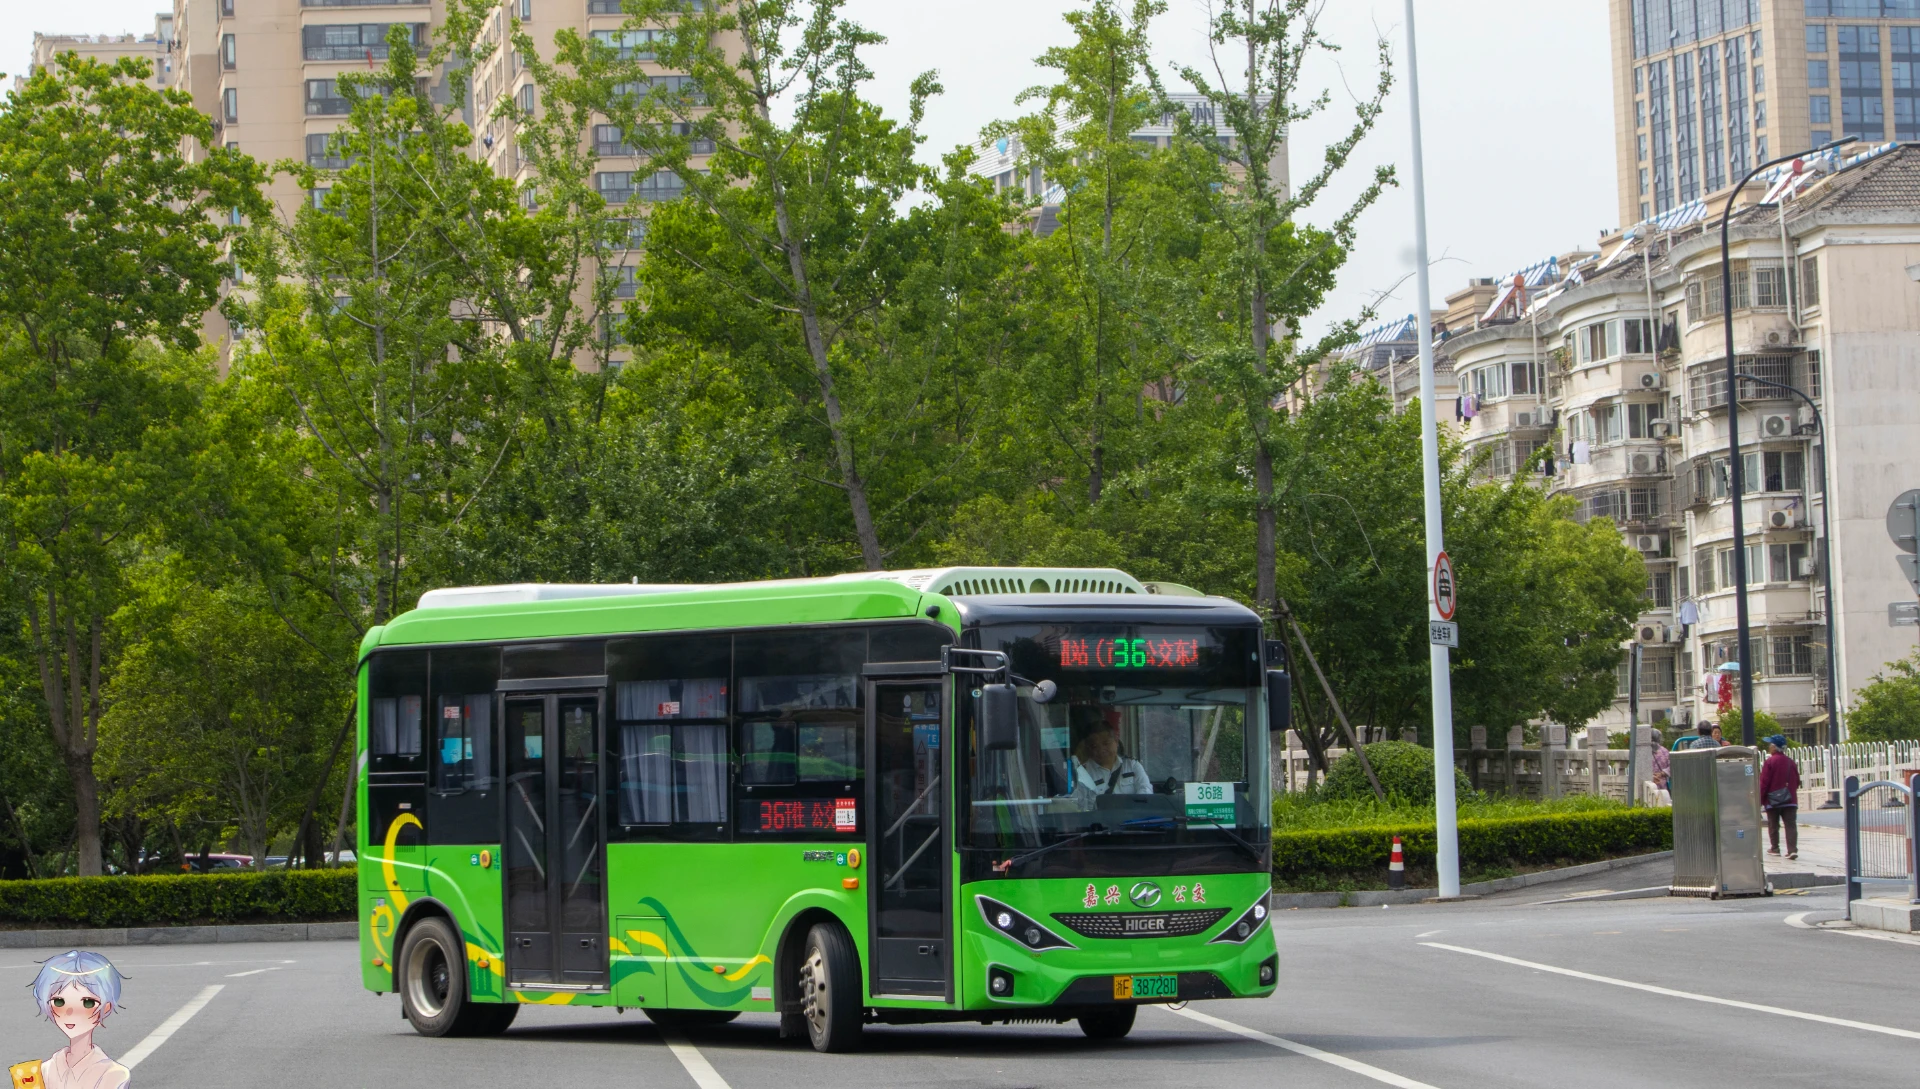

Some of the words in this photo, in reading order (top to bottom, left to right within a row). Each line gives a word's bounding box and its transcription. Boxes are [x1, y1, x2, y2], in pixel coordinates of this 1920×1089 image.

[1114, 638, 1146, 667] 36
[1197, 786, 1223, 800] 36路
[1083, 883, 1121, 908] 嘉兴
[1172, 883, 1206, 903] 公交
[1125, 918, 1165, 931] HIGER
